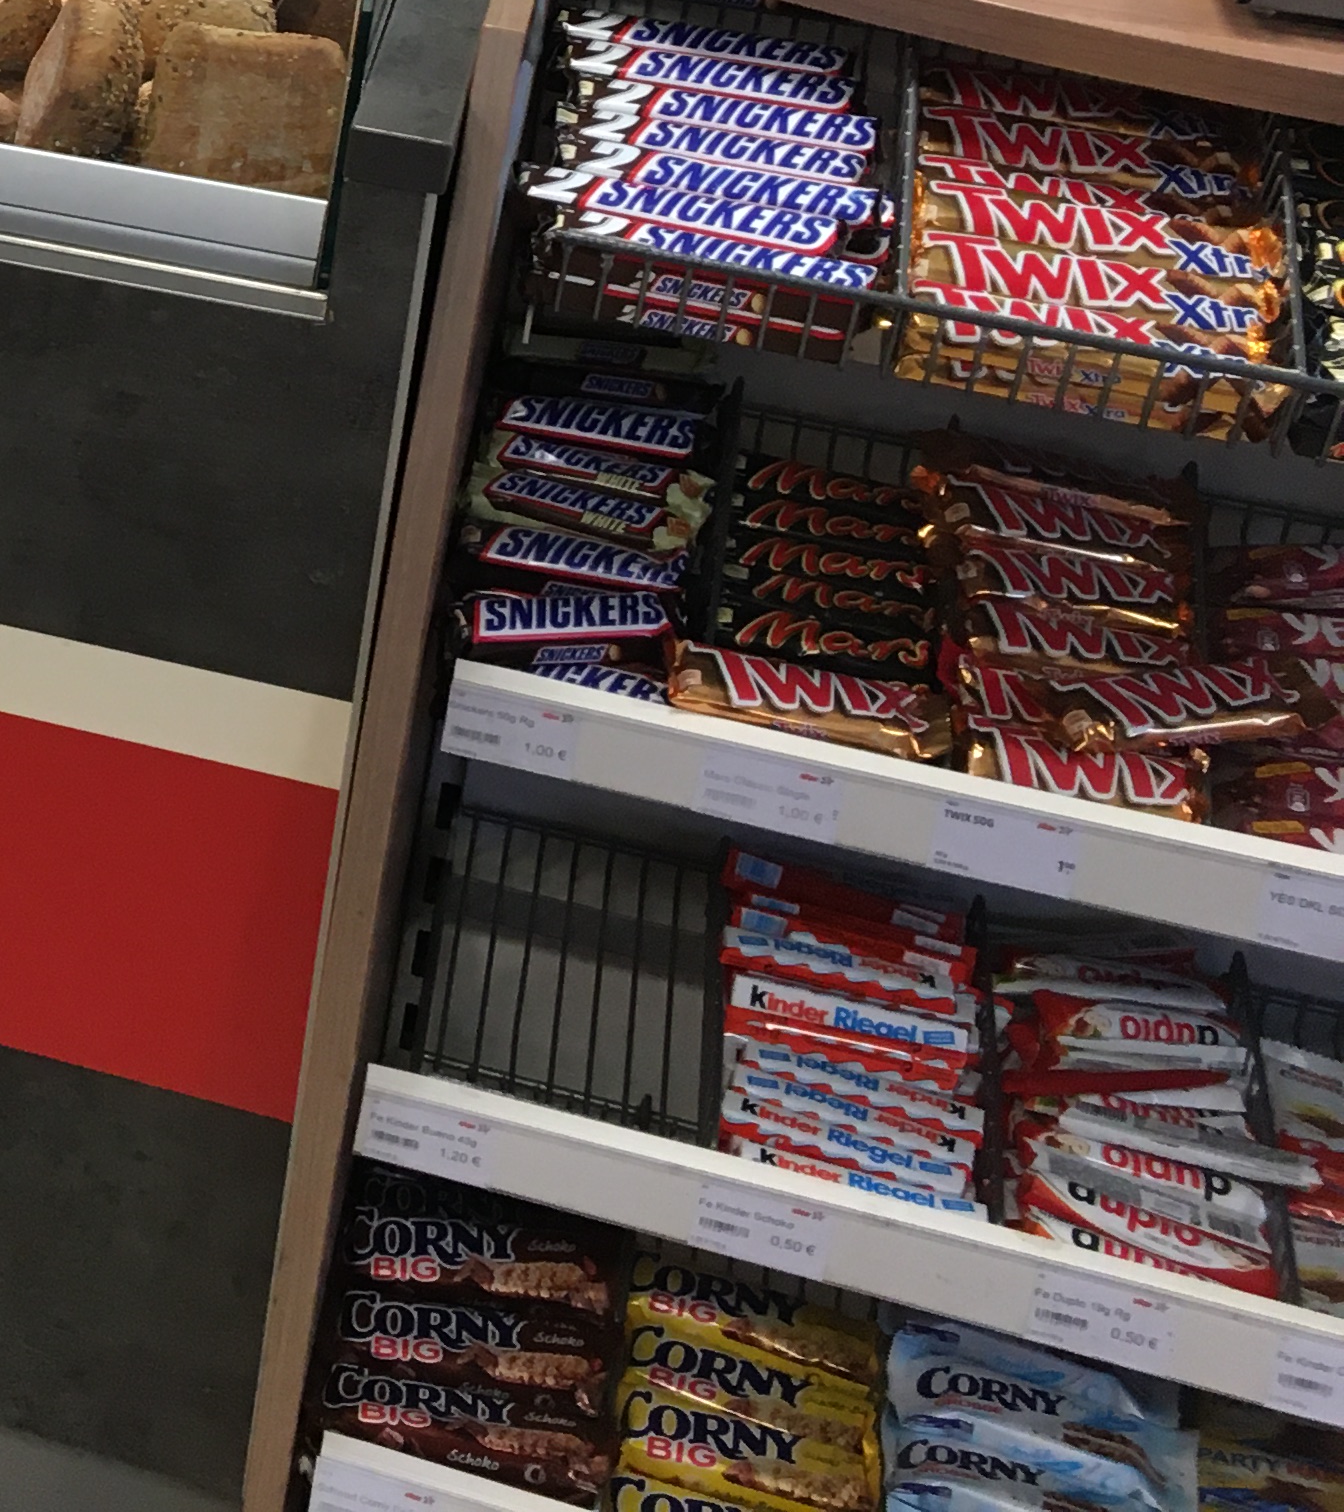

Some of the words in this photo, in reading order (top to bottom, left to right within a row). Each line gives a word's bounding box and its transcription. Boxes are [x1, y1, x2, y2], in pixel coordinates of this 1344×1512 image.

[632, 18, 849, 72] SNICKERS
[637, 51, 854, 106] SNICKERS
[928, 66, 1144, 117] TWIX
[658, 89, 877, 149] SNICKERS
[923, 106, 1158, 173] TWIX
[644, 121, 866, 179] SNICKERS
[597, 179, 837, 245] SNICKERS
[642, 153, 874, 225] SNICKERS
[930, 180, 1174, 254] TWIX
[923, 232, 1171, 310] TWIX
[1166, 293, 1259, 333] Xtr
[515, 397, 694, 449] SNICKERS
[511, 434, 664, 486] SNICKERS
[497, 474, 655, 527] SNICKERS
[580, 509, 627, 534] WHITE
[946, 473, 1172, 559] TWIX
[739, 538, 930, 589] Mars
[966, 547, 1174, 604] TWIX
[485, 592, 665, 632] SNICKERS
[735, 610, 930, 667] Mars
[978, 599, 1188, 666] TWIX
[536, 646, 606, 663] SNICKERS
[685, 639, 930, 733] TWIX
[1049, 656, 1301, 738] TWIX
[943, 807, 972, 824] TWIX
[749, 984, 829, 1025] kinder
[833, 1006, 918, 1043] Riegel
[740, 1097, 823, 1137] kinder
[827, 1127, 914, 1170] Riegel
[472, 1155, 482, 1168] €
[760, 1147, 842, 1183] kinder
[1101, 1142, 1232, 1202] duplo
[344, 1206, 523, 1270] CORNY
[806, 1245, 817, 1257] €
[370, 1256, 441, 1282] BIG
[628, 1251, 808, 1327] CORNY
[338, 1290, 529, 1353] CORNY
[647, 1291, 718, 1324] BIG
[370, 1335, 444, 1364] BIG
[630, 1325, 814, 1409] CORNY
[322, 1362, 515, 1428] CORNY
[647, 1365, 718, 1402] BIG
[916, 1365, 1067, 1417] CORNY
[358, 1401, 432, 1428] BIG
[621, 1390, 805, 1465] CORNY
[446, 1449, 500, 1472] Schoko
[645, 1435, 718, 1468] BIG
[897, 1439, 1046, 1487] CORNY
